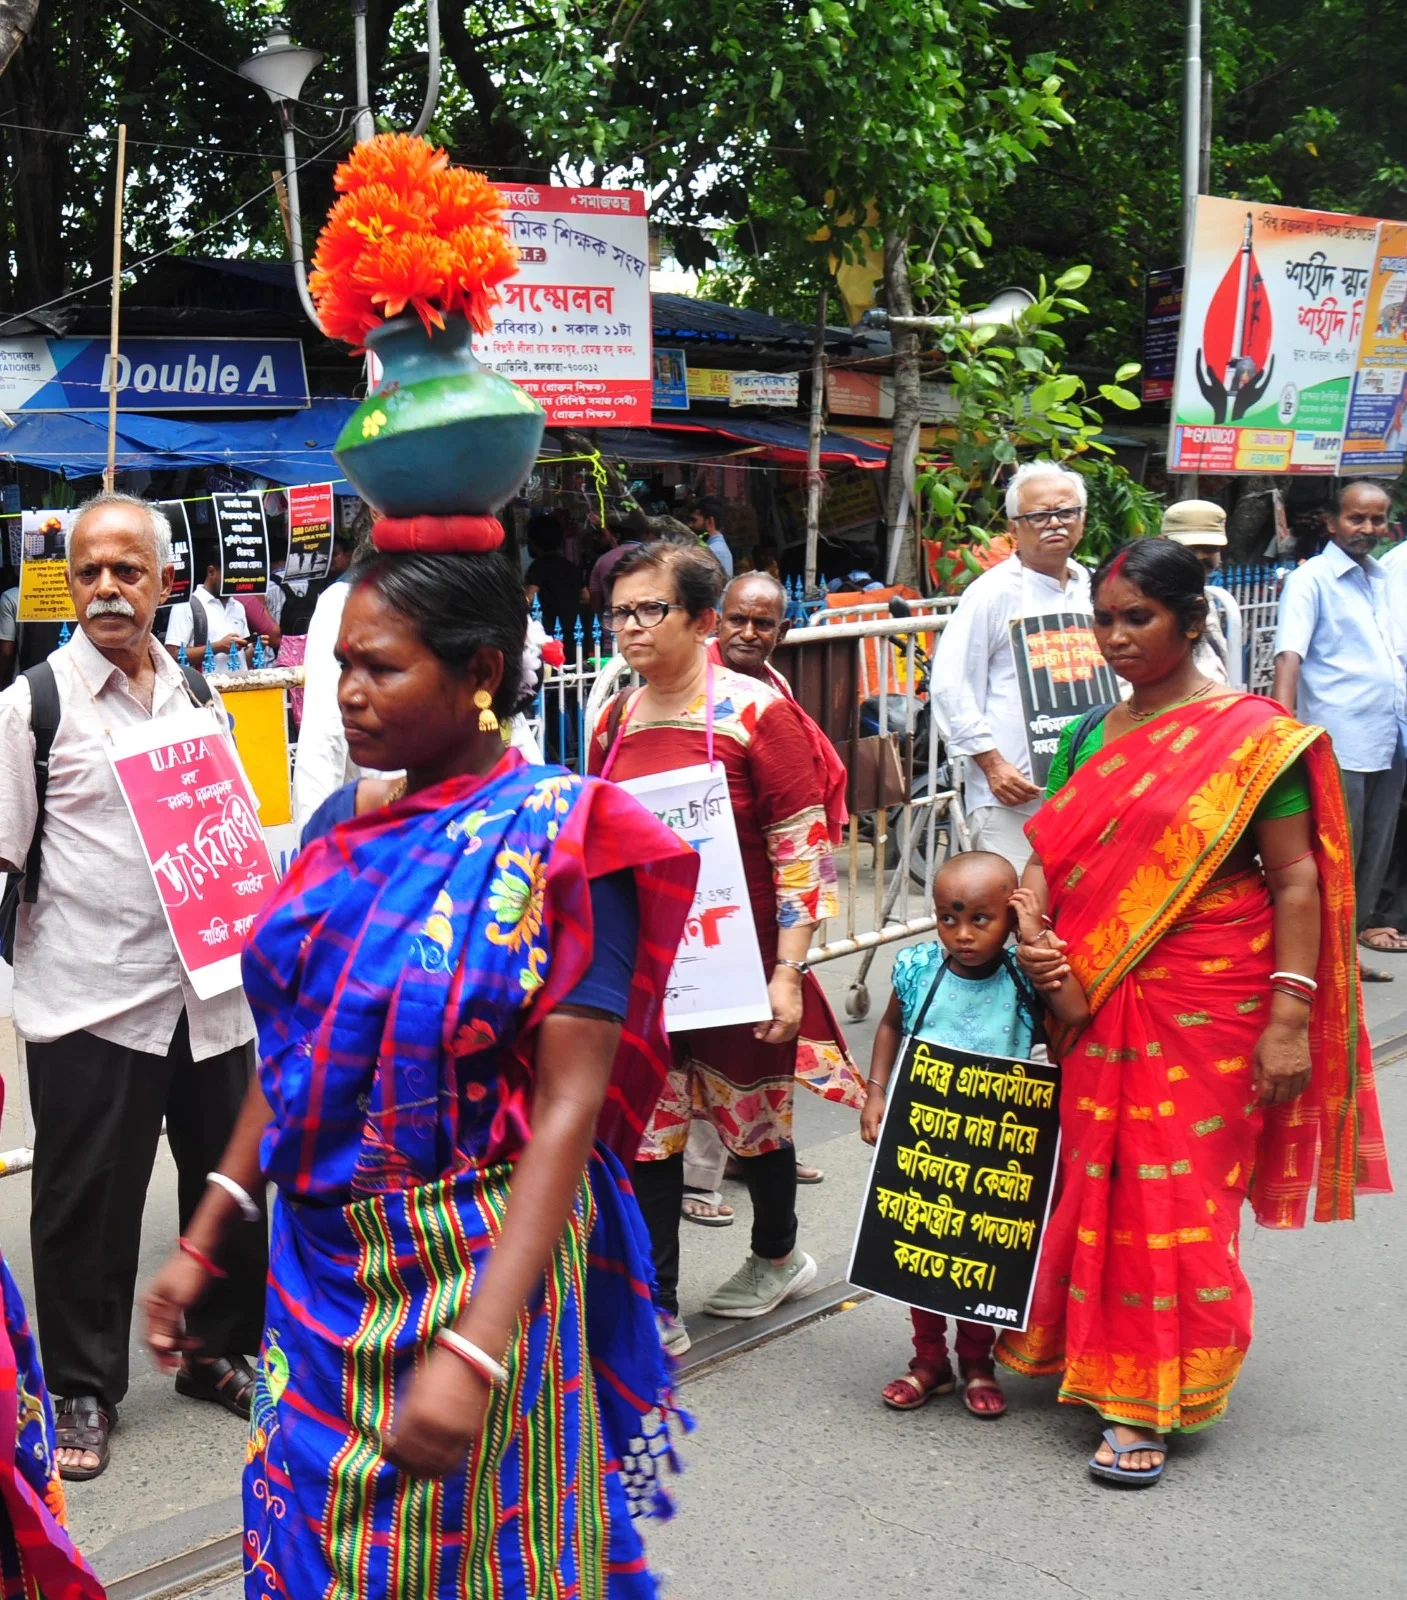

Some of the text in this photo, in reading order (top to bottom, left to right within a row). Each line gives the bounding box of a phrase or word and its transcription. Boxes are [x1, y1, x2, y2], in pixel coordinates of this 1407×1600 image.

[552, 218, 608, 257] শিক্ষক
[612, 245, 647, 278] সংঘ
[503, 283, 615, 315] সম্মেলন
[1285, 251, 1337, 300] শহীদ
[493, 319, 632, 337] রবিবার) সকাল ১১টা
[1298, 297, 1347, 345] শহীদ
[99, 353, 277, 393] Double A
[181, 769, 199, 786] সহ
[232, 872, 269, 896] আইন
[910, 1044, 1055, 1109] নিরস্ত্র গ্রামবাসীদের
[909, 1102, 1039, 1155] হত্যার দায় নিয়ে
[897, 1141, 1034, 1202] অবিলম্বে কেন্দ্রীয়
[877, 1186, 1035, 1250] স্বরাষ্ট্রমন্ত্রীর পদত্যাগ
[894, 1240, 997, 1292] করতে হবে।
[974, 1303, 1018, 1322] APDR
